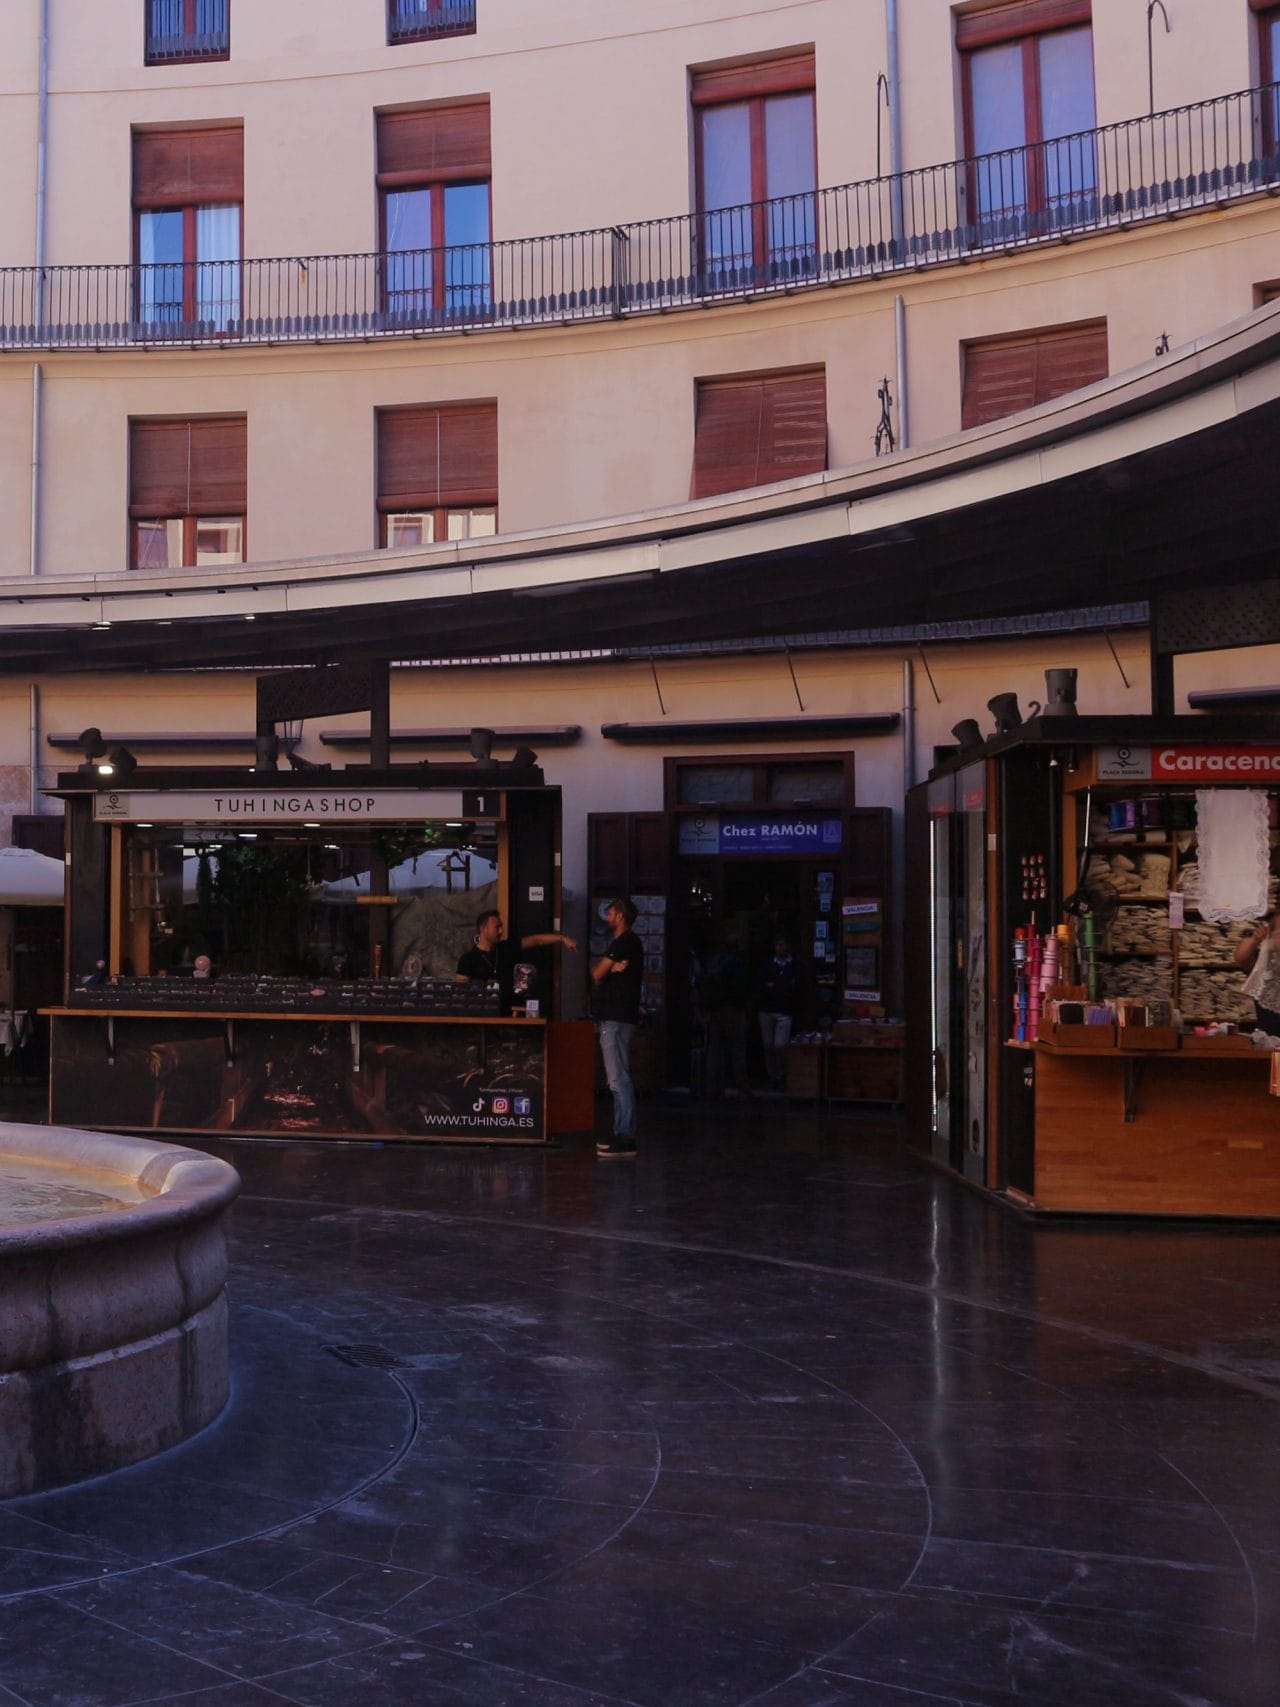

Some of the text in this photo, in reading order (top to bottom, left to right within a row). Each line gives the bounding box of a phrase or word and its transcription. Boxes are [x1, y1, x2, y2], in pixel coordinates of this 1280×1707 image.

[214, 798, 375, 813] TUHINGASHOP
[477, 796, 485, 812] 1
[722, 821, 818, 837] Chez RAMÓN
[847, 905, 873, 913] VALENCIA
[424, 1115, 535, 1128] WWW.TUHINGA.ES
